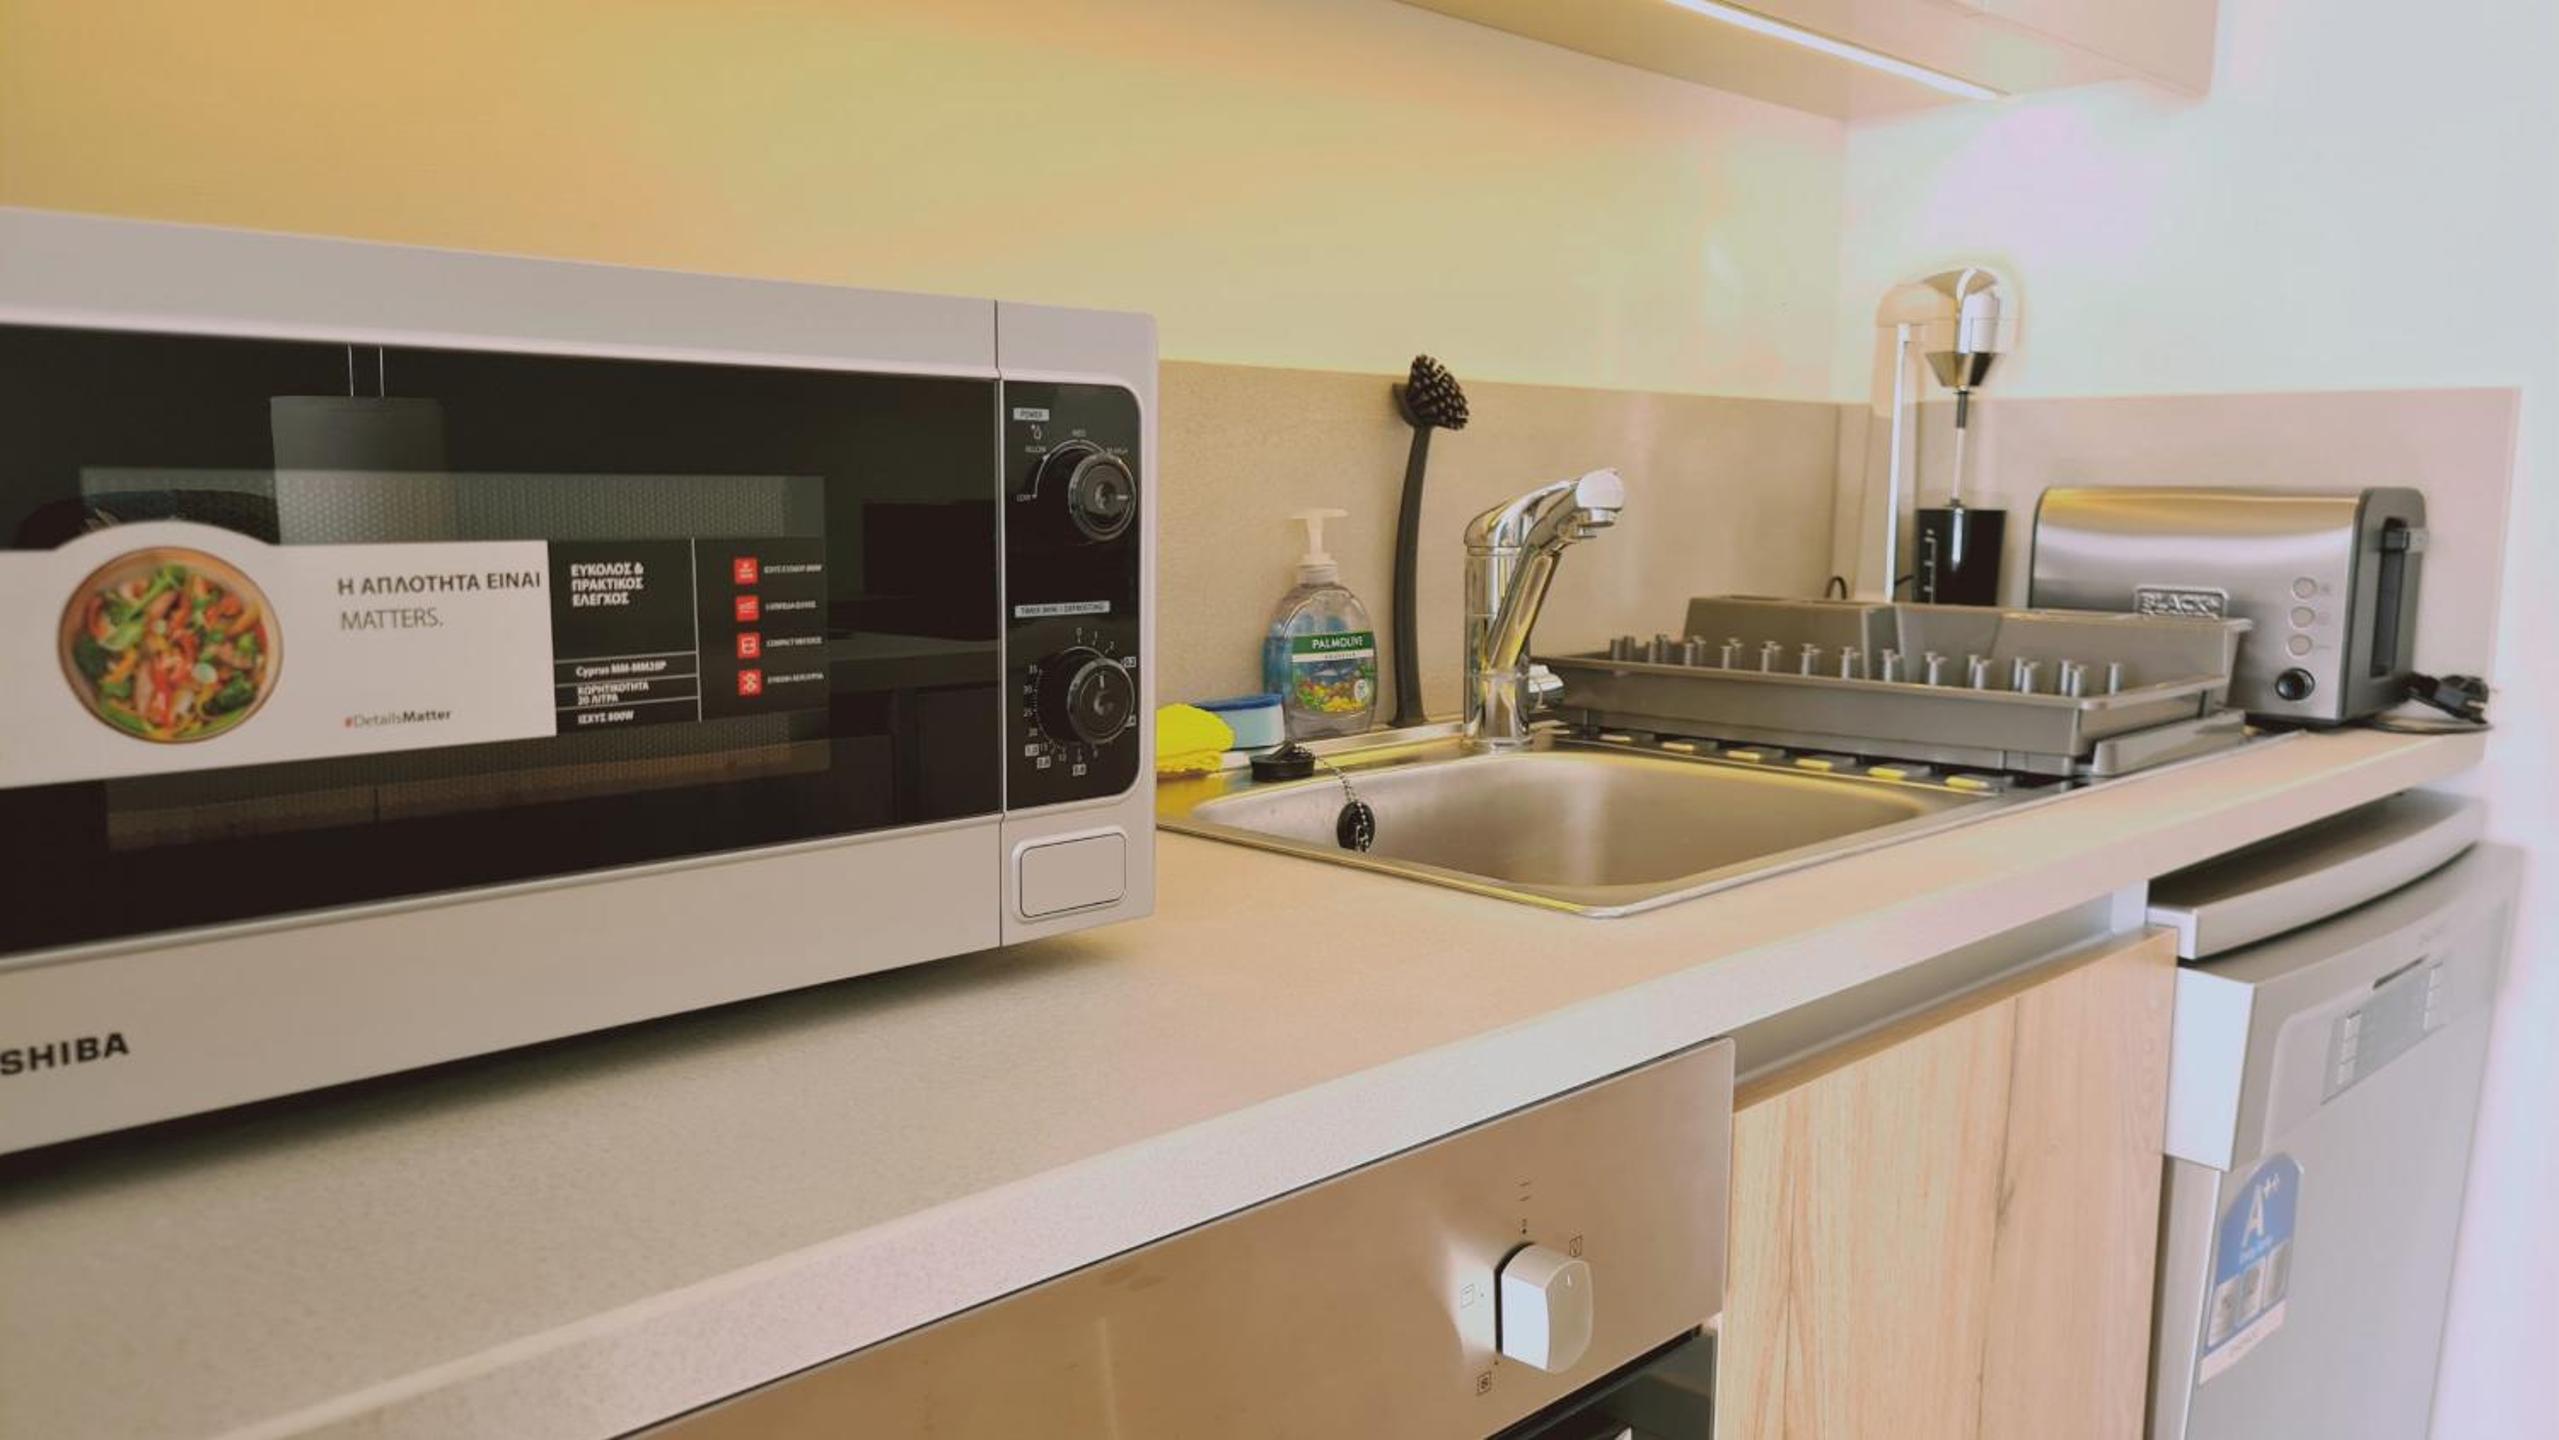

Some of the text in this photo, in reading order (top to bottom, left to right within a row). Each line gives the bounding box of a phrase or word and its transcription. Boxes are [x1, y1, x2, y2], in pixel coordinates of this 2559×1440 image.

[340, 606, 444, 631] MATTERS.
[575, 665, 610, 678] Cyprus
[344, 709, 452, 728] #DetailsMatter
[0, 1031, 130, 1076] SHIBA
